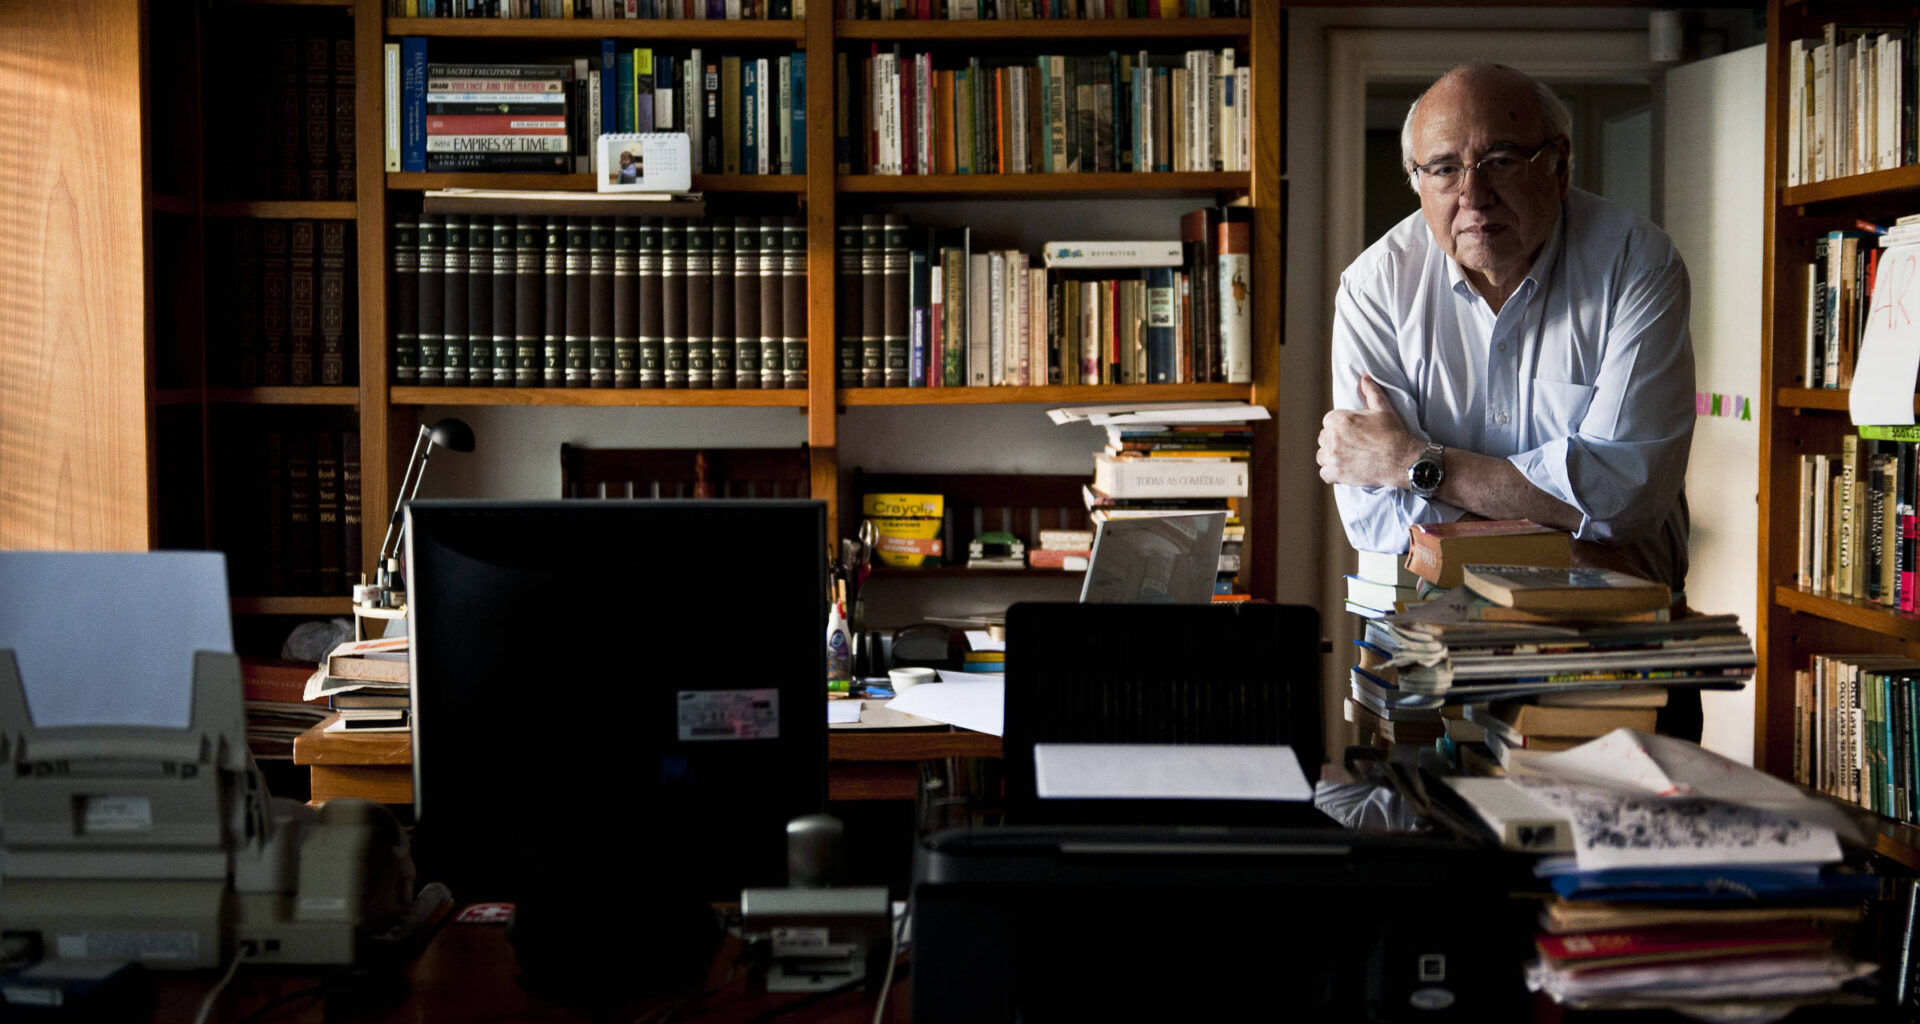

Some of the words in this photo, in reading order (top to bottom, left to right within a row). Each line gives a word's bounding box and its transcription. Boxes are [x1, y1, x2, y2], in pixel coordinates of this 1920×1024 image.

[430, 66, 446, 76] THE
[446, 66, 472, 76] SACRED
[474, 66, 522, 77] EXECUTIONER
[451, 82, 483, 91] VIOLENCE
[486, 82, 501, 91] AND
[503, 82, 516, 91] THE
[518, 81, 545, 91] SACRED
[453, 137, 501, 151] EMPIRES
[503, 138, 514, 151] OF
[520, 137, 549, 151] TIME
[1735, 394, 1752, 421] PA
[1135, 476, 1165, 486] TODAS
[1167, 477, 1179, 486] AS
[1179, 473, 1226, 486] COMÉDIAS
[1842, 465, 1853, 502] John
[1842, 504, 1852, 521] le
[1876, 499, 1884, 531] SMALL
[1841, 523, 1852, 569] Carré
[1896, 525, 1904, 545] THE
[1874, 535, 1883, 567] TOWN
[1895, 550, 1904, 592] TAILOR
[1839, 738, 1847, 787] RESENDE
